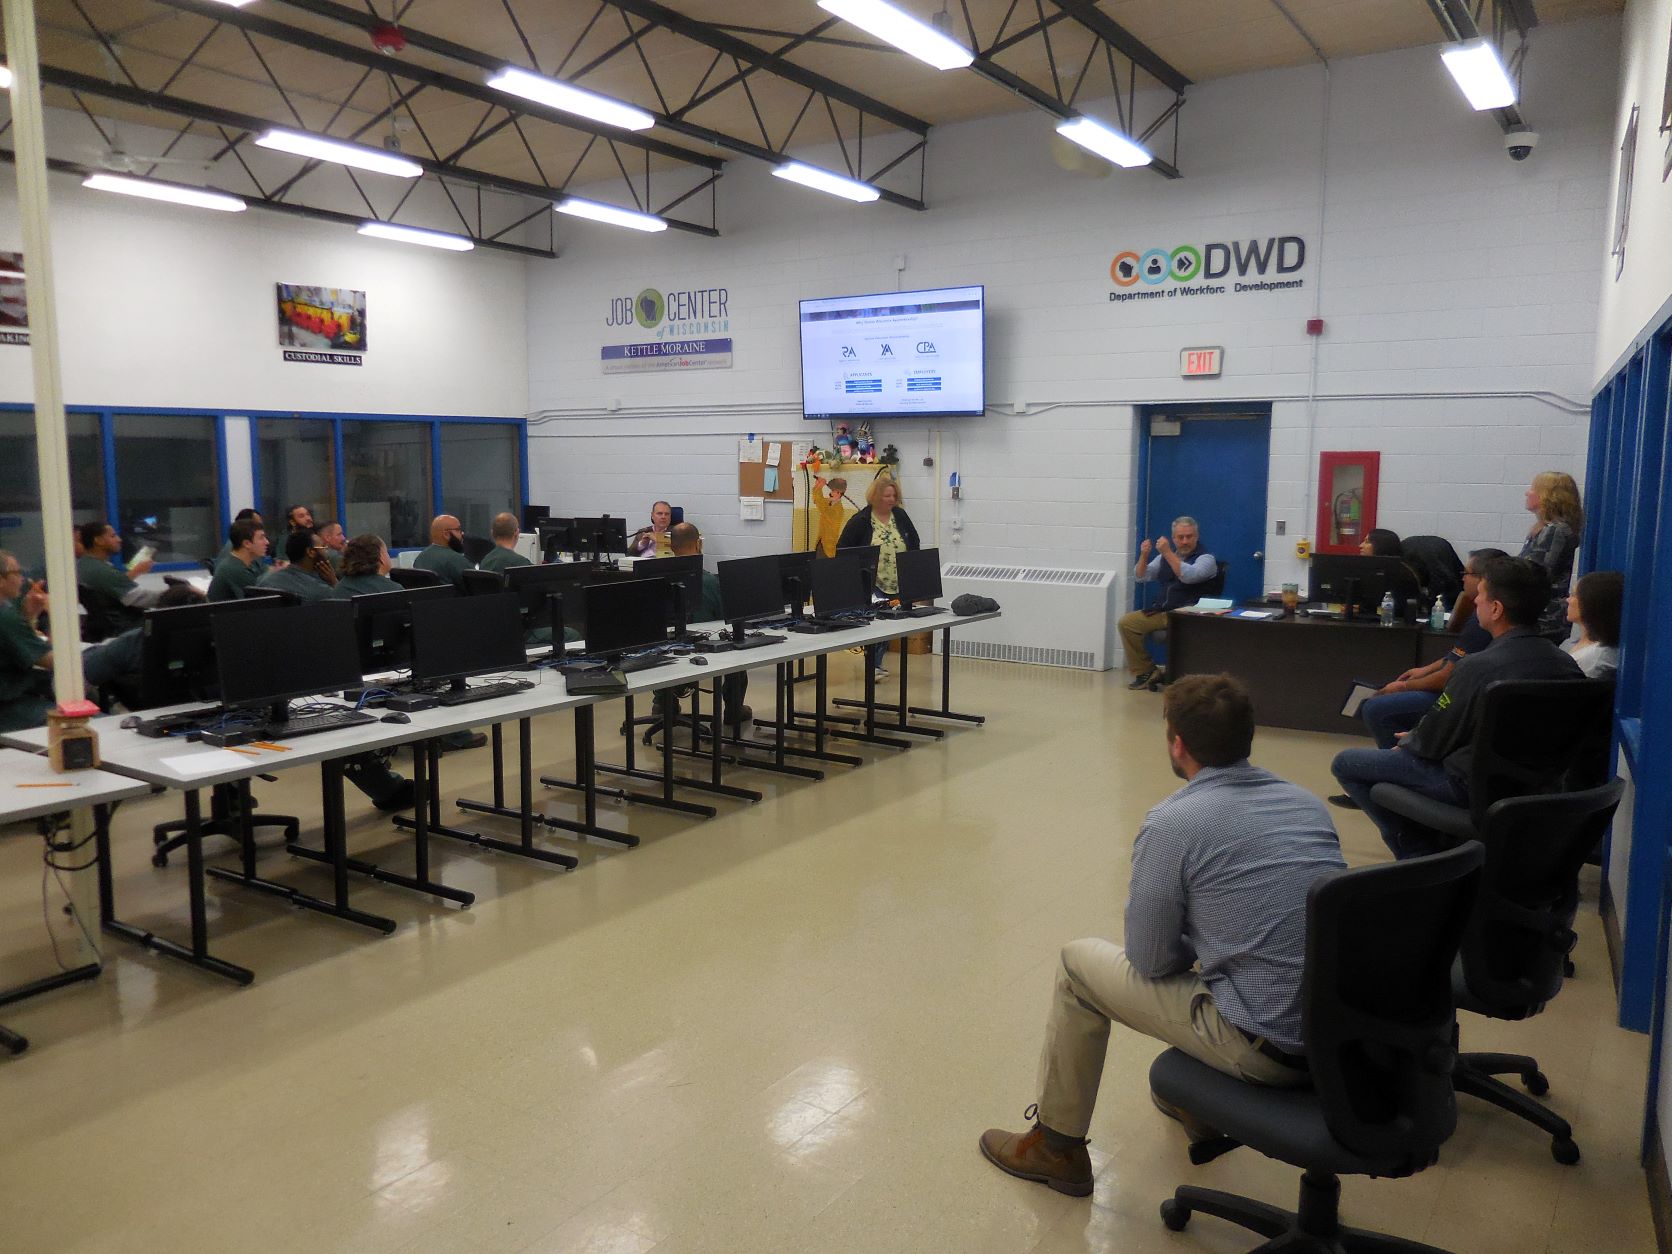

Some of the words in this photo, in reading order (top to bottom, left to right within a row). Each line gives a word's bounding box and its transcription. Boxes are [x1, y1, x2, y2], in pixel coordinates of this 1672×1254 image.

[1204, 236, 1305, 279] DWD
[1109, 286, 1165, 302] Department
[1167, 287, 1178, 298] of
[1179, 285, 1225, 297] Workforc
[1234, 279, 1303, 293] Development
[606, 297, 634, 327] JOB
[667, 288, 729, 322] CENTER
[656, 325, 667, 340] of
[669, 320, 729, 337] WISCONSIN
[285, 351, 332, 363] CUSTODIAL
[333, 355, 361, 364] SKILLS
[624, 344, 659, 357] KETTLE
[660, 341, 706, 355] MORAINE
[1187, 351, 1215, 373] EXIT
